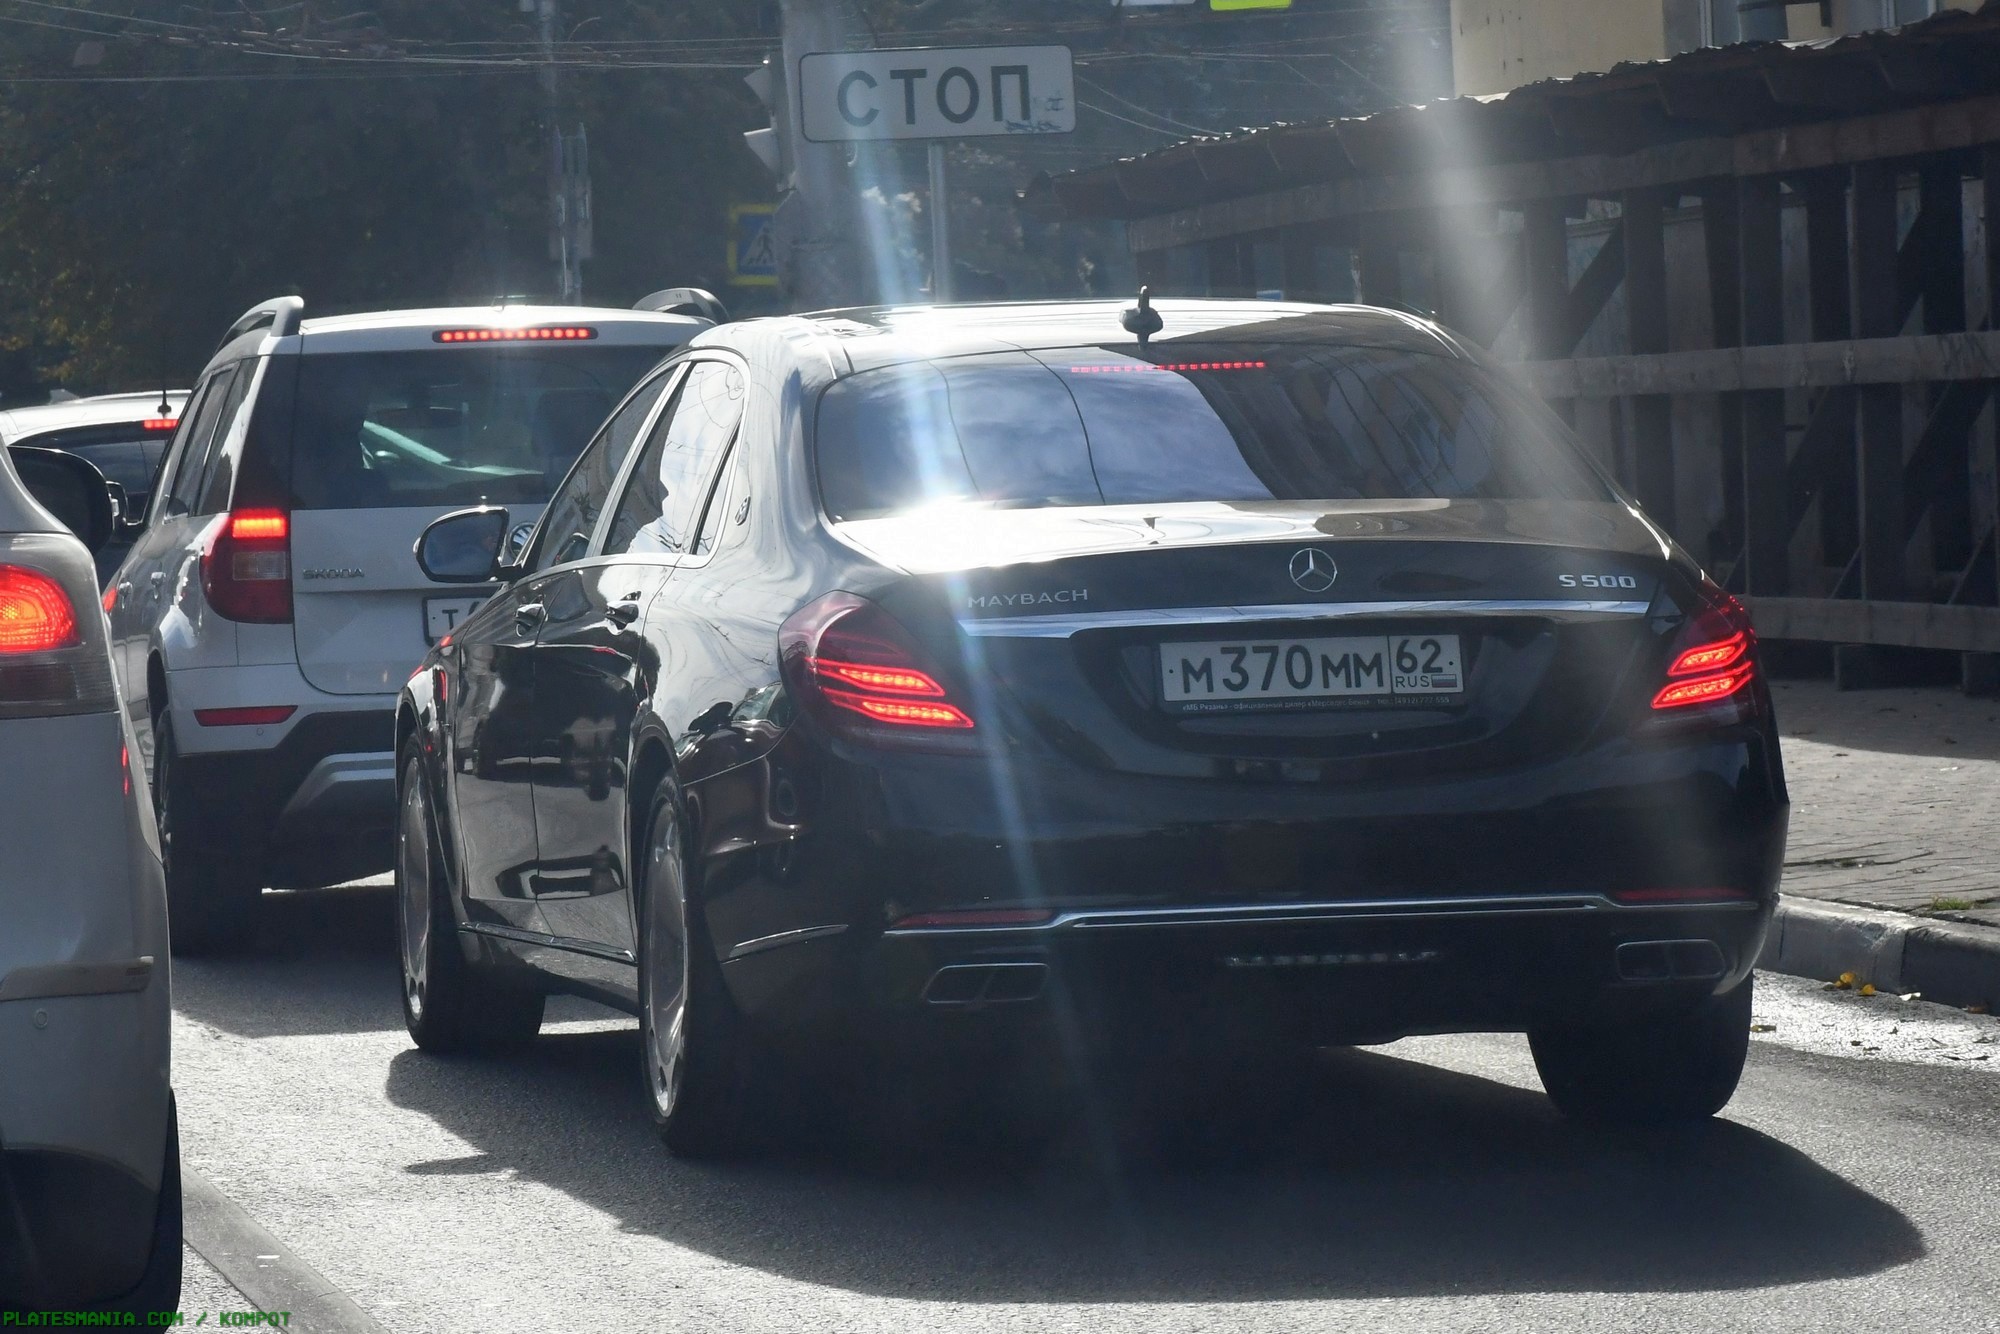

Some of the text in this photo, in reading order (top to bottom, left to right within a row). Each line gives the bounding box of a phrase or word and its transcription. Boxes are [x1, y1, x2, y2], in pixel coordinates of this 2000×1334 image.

[837, 65, 1031, 128] СТОП
[1558, 574, 1637, 589] S 500
[967, 588, 1088, 609] MAYBACH
[1181, 638, 1444, 695] М370ММ 62
[1395, 674, 1430, 689] RUS
